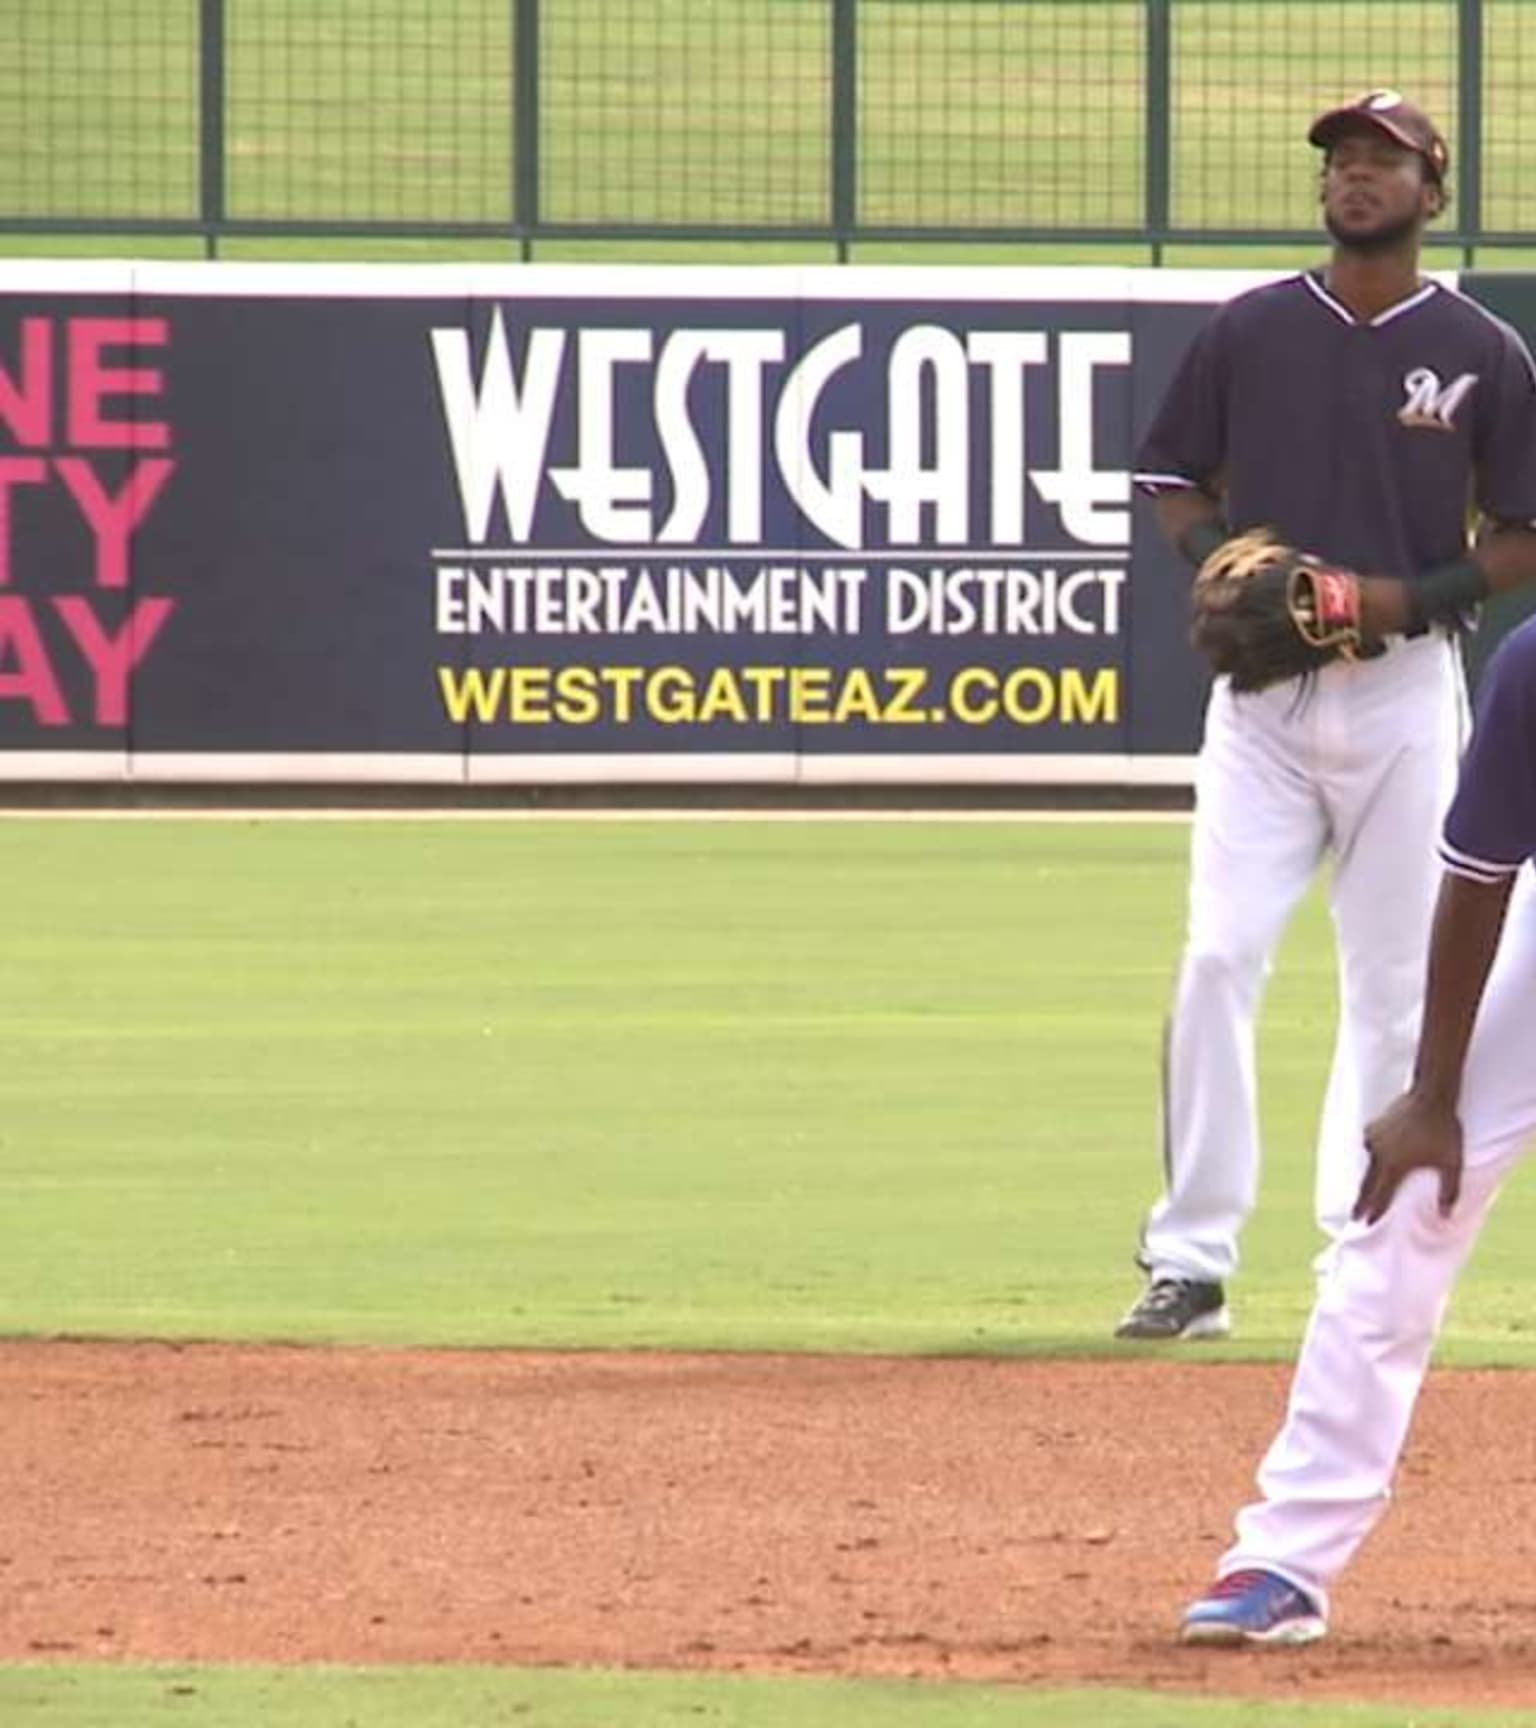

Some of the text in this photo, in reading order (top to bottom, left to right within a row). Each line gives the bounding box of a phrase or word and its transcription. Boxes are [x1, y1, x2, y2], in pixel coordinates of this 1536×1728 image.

[431, 304, 1131, 552] WESTGATE
[436, 567, 1126, 635] ENTERTAINMENT DISTRICT
[438, 666, 1118, 724] WESTGATEAZ.COM
